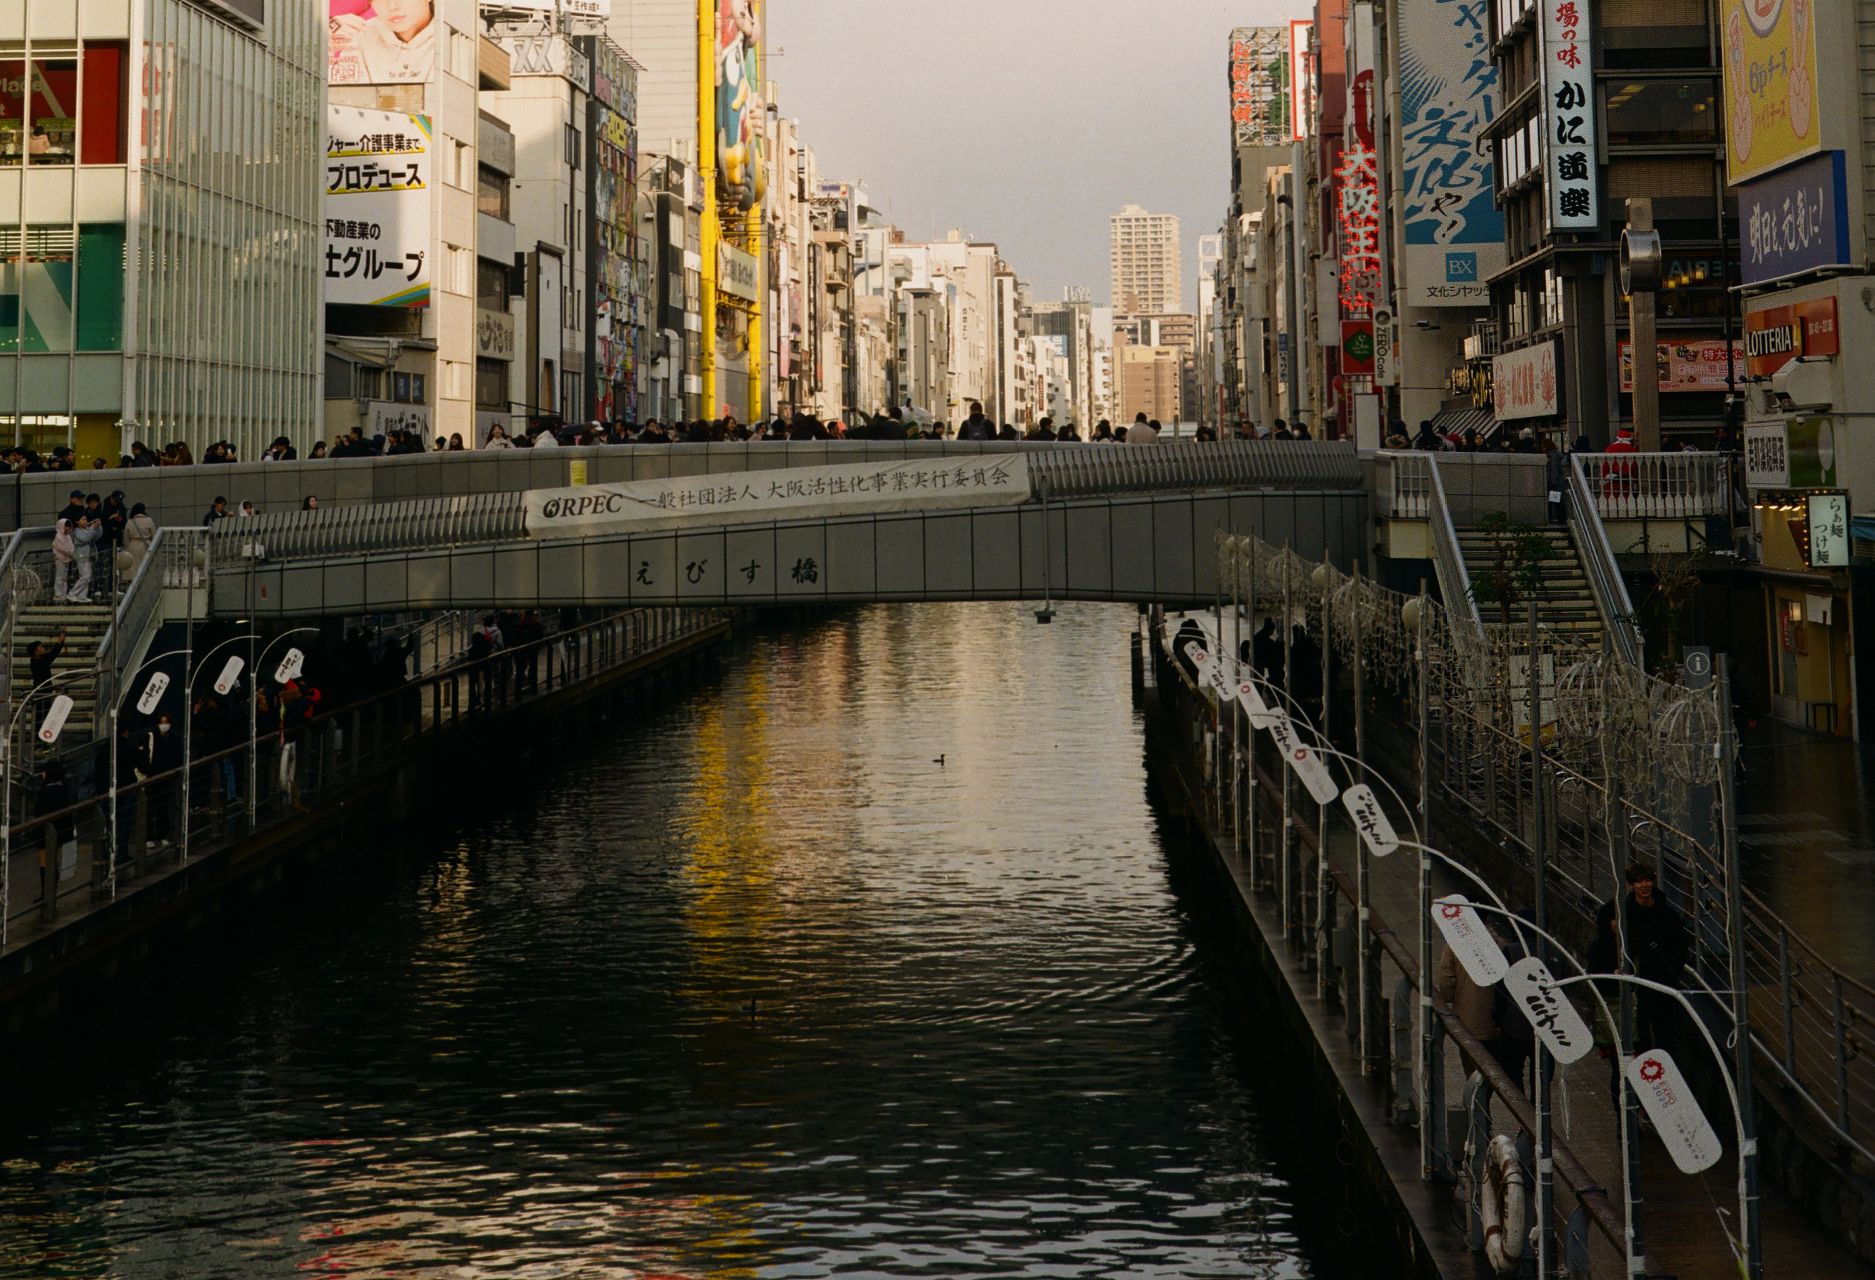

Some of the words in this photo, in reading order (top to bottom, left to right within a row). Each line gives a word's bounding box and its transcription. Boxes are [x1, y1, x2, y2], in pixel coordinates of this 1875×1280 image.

[327, 163, 423, 190] プロデュース
[1449, 259, 1474, 275] BX
[1747, 325, 1792, 357] LOTTERIA
[638, 483, 760, 509] 一般社団法人
[766, 465, 1011, 499] 大阪活性化事業実行委員会
[635, 557, 820, 586] えびす橋
